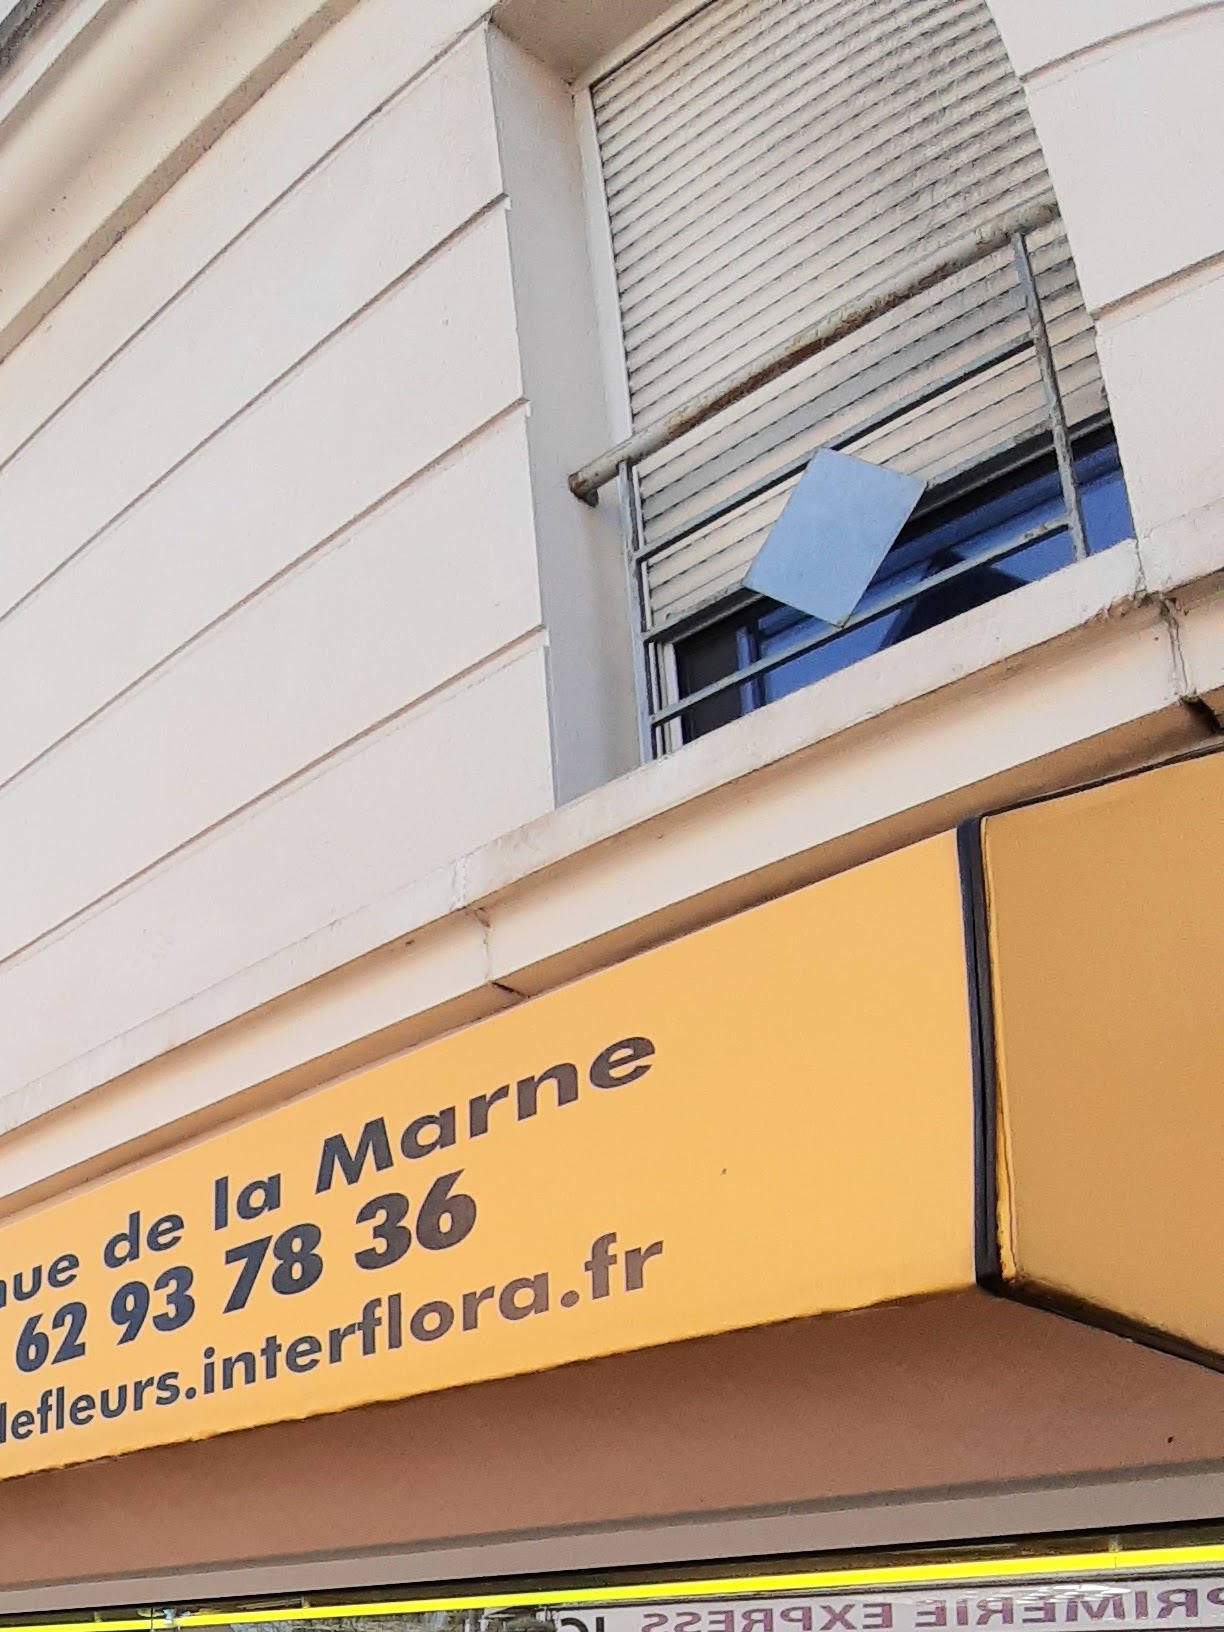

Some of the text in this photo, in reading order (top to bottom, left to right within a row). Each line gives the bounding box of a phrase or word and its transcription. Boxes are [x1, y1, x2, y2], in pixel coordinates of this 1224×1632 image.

[103, 1210, 185, 1269] de
[214, 1174, 282, 1233] la
[315, 1034, 657, 1195] Marne
[15, 1301, 87, 1374] 62
[109, 1267, 197, 1347] 93
[222, 1222, 325, 1314] 78
[354, 1170, 478, 1270] 36
